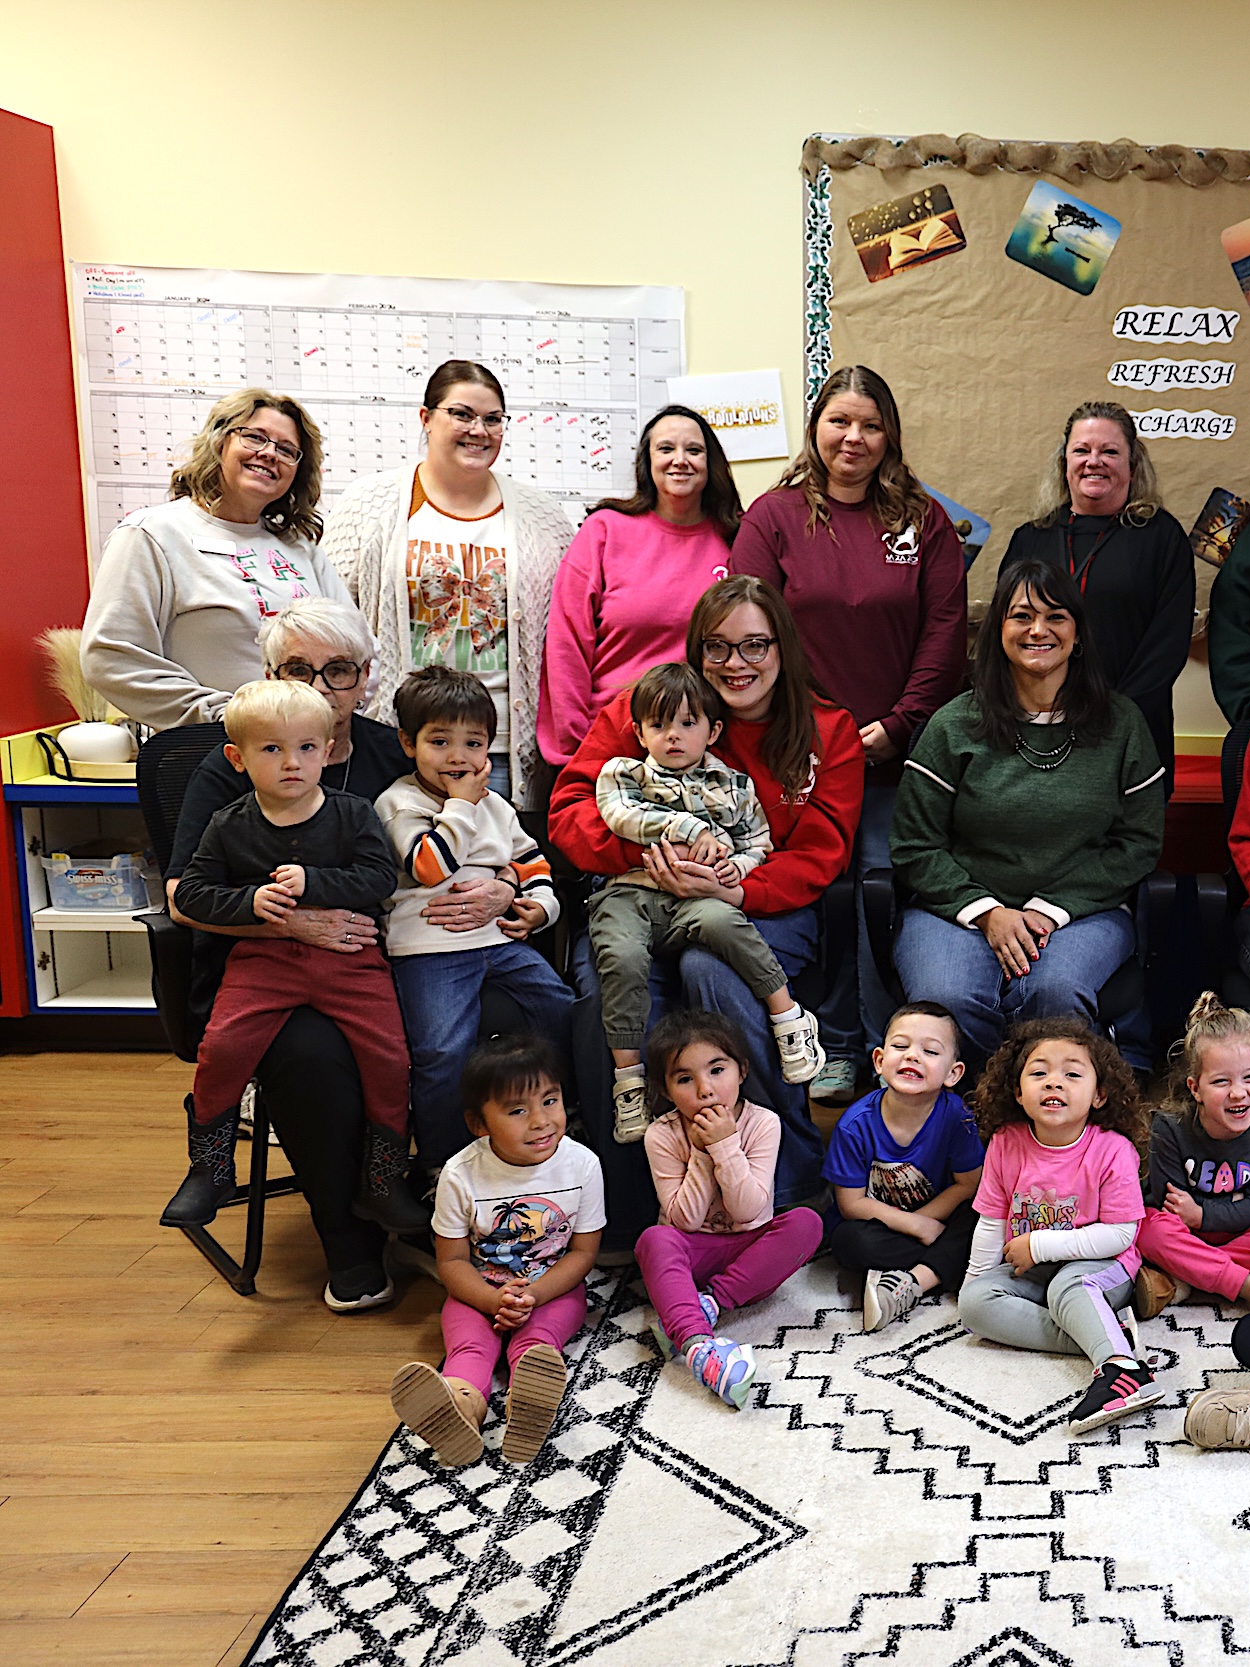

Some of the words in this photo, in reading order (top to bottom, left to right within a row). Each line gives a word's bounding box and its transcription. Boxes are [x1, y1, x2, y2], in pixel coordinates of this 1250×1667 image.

[1115, 310, 1239, 338] RELAX
[492, 356, 523, 366] Spring
[535, 357, 563, 366] Break
[1111, 363, 1235, 387] REFRESH
[705, 406, 777, 427] RATULATIONS
[1131, 414, 1236, 437] CHARGE
